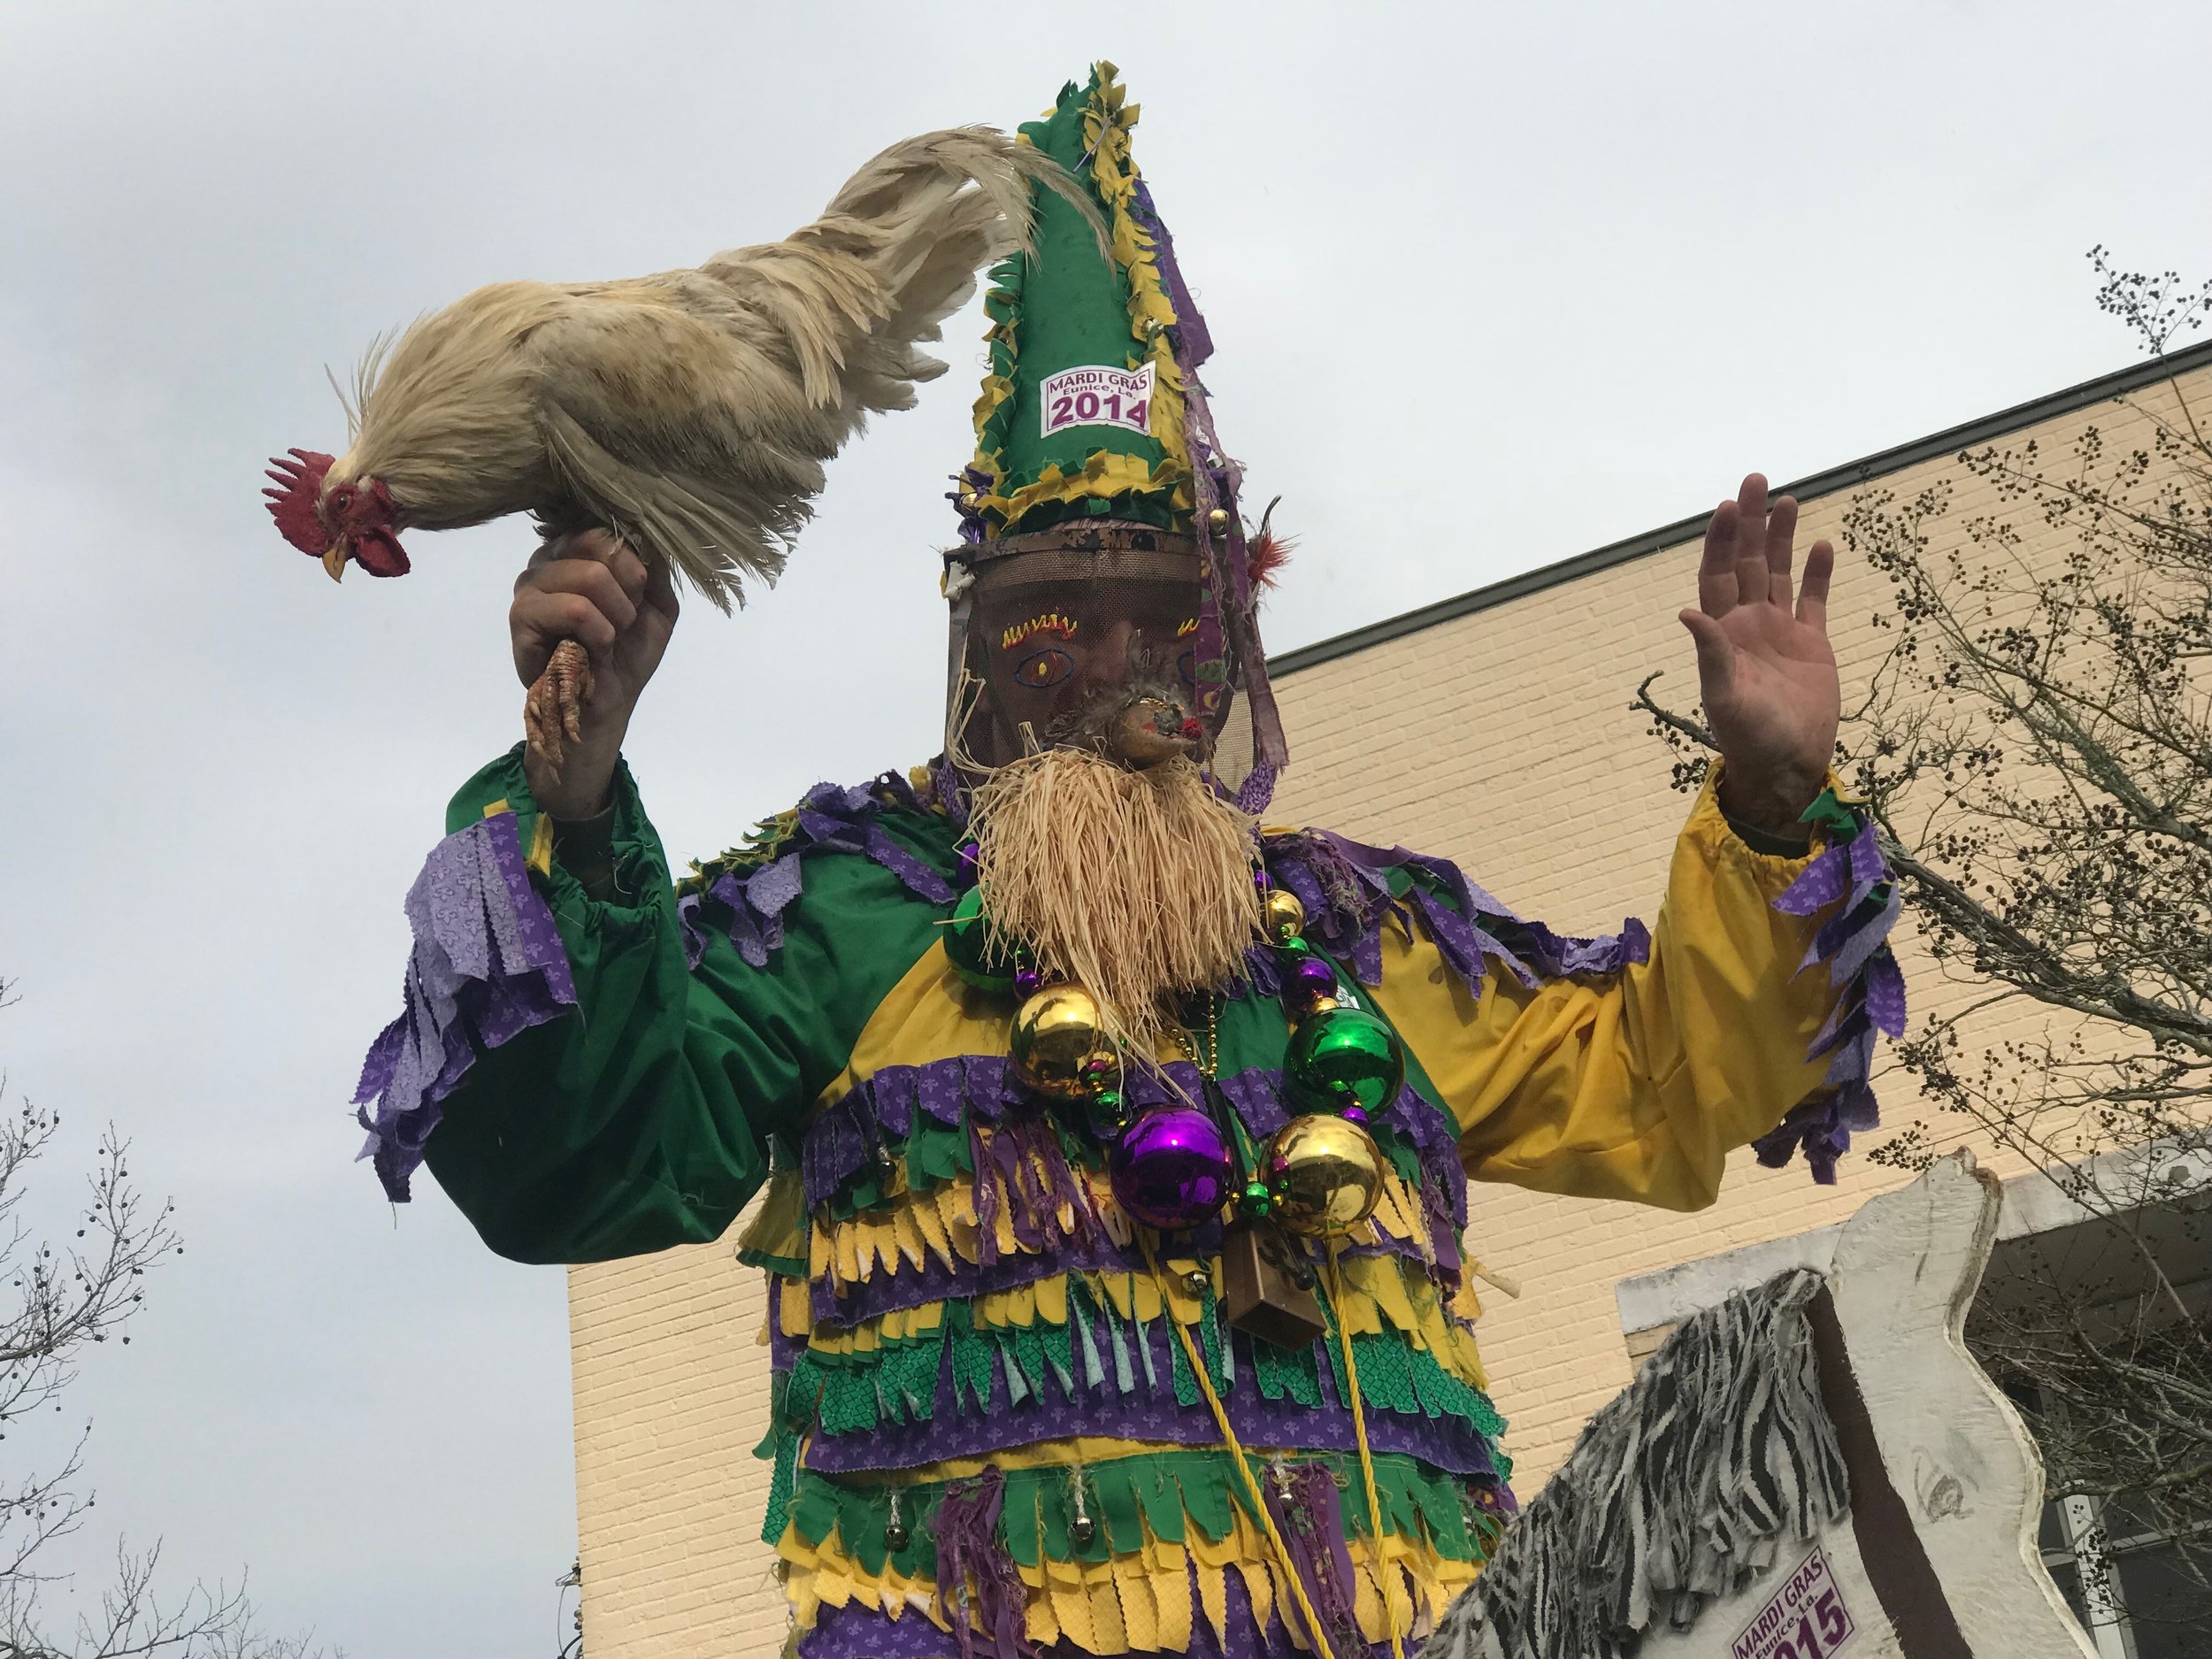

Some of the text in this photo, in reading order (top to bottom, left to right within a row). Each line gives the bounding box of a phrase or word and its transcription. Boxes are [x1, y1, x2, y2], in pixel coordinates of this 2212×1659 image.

[1049, 373, 1148, 394] MARDI GRAS
[1063, 384, 1137, 400] Eunice, La.
[1050, 392, 1147, 429] 2014
[1737, 1555, 1823, 1659] MARDI GRAS
[1798, 1594, 1818, 1615] La.
